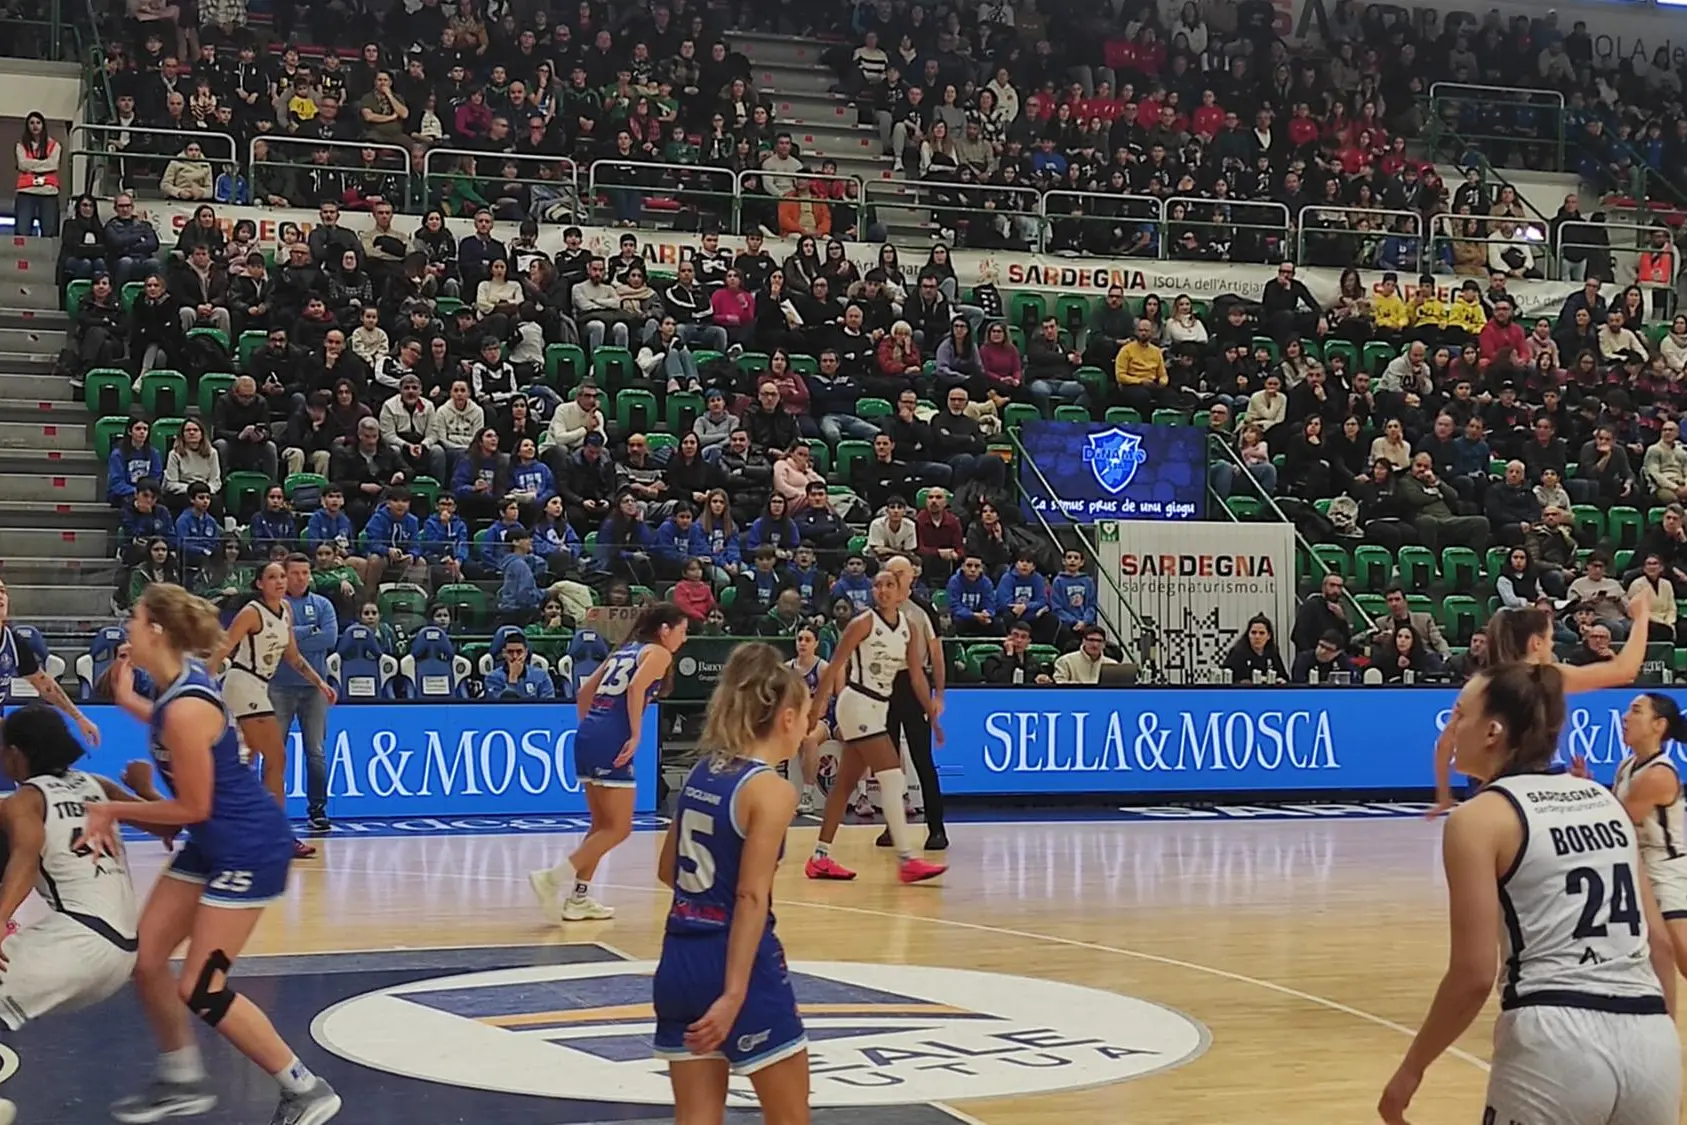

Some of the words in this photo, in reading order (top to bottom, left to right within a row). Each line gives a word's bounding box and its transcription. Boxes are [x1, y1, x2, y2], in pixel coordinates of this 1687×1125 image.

[1008, 264, 1147, 290] SARDEGNA
[1153, 276, 1191, 289] ISOLA
[1194, 278, 1263, 296] dell'Artigia
[1122, 498, 1135, 512] de
[1140, 501, 1161, 512] unu
[1165, 501, 1195, 517] giogu
[1122, 554, 1274, 577] SARDEGNA
[1122, 580, 1275, 596] sardegnaturismo.it
[597, 657, 636, 696] 23
[984, 709, 1341, 772] SELLA&MOSCA
[676, 808, 716, 894] 5
[1549, 819, 1629, 856] BOROS
[209, 870, 254, 893] 25
[1565, 862, 1641, 940] 24
